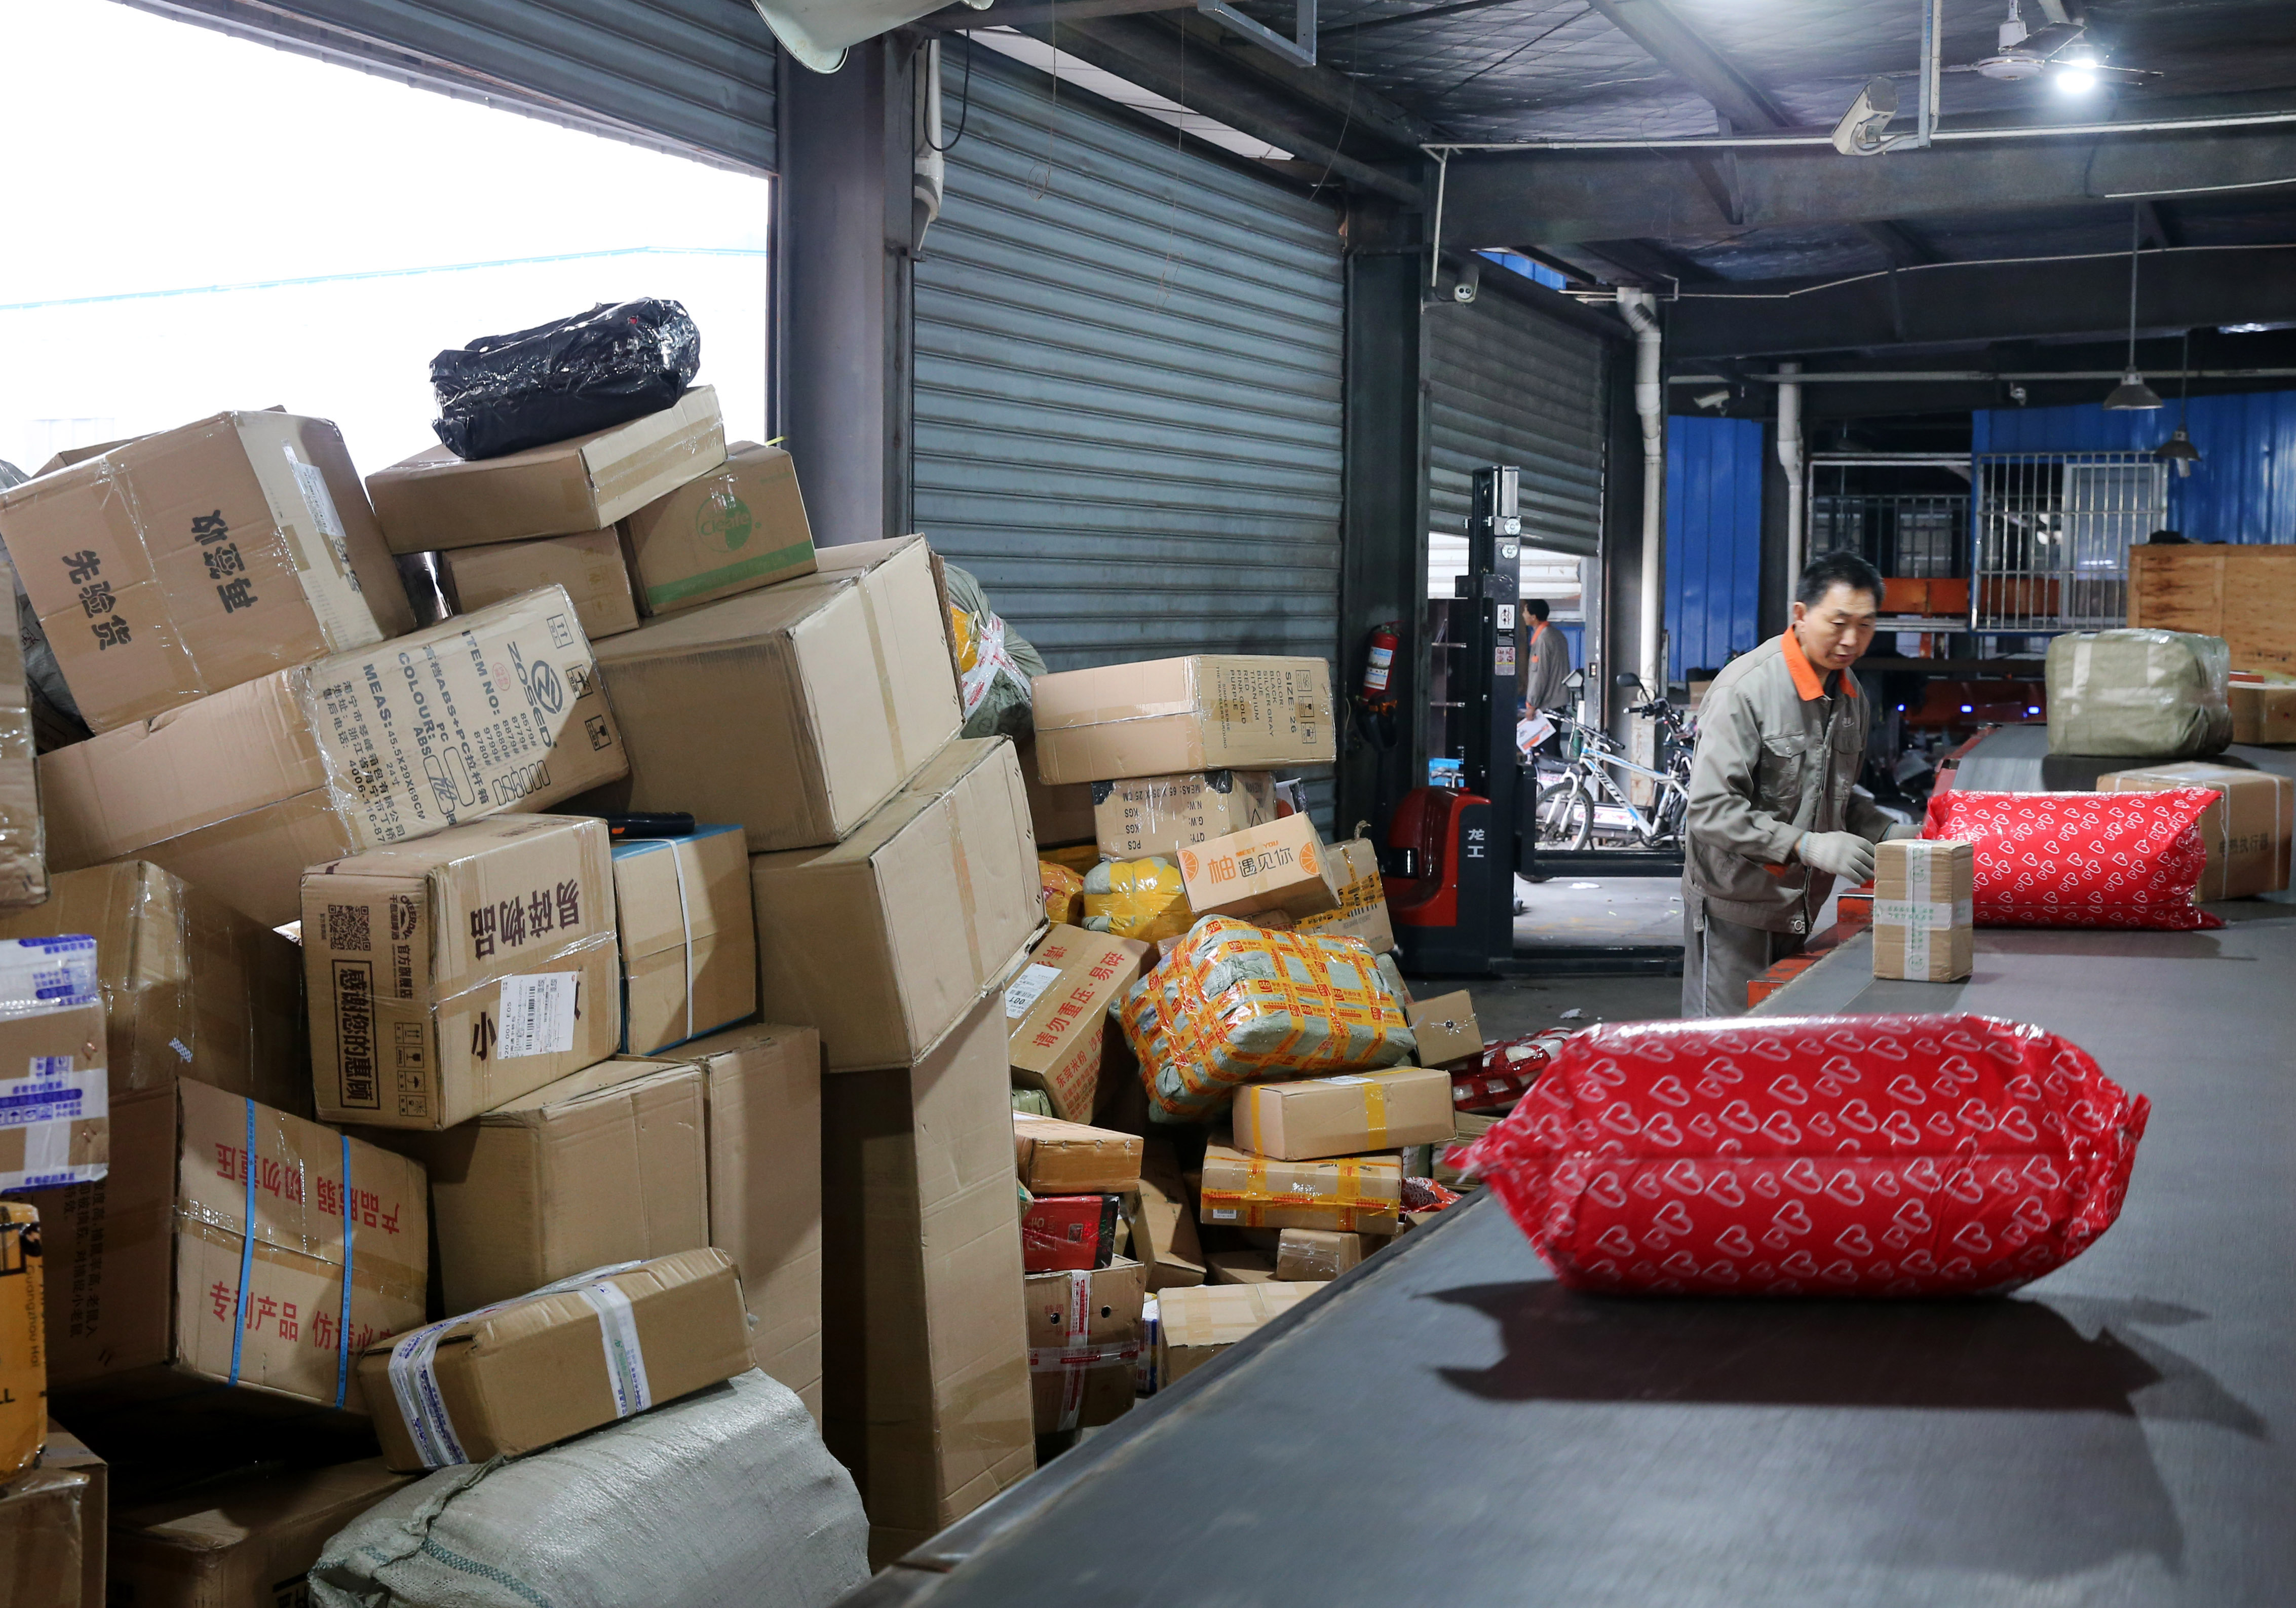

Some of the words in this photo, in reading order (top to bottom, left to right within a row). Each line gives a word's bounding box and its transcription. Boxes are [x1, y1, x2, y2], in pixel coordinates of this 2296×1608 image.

[191, 509, 258, 614] 再签收
[62, 550, 132, 651] 先验货
[462, 630, 487, 677] ITEM
[482, 681, 501, 716] NO:
[1230, 669, 1238, 710] PURPLE
[398, 652, 436, 741] COLOUR:
[507, 641, 552, 747] ZOSED
[1285, 671, 1295, 711] SIZE:
[363, 663, 393, 729] MEAS:
[388, 730, 426, 820] 45.5X29X69CM
[413, 727, 432, 757] ABS
[436, 722, 450, 742] PC
[493, 723, 511, 758] 8680#
[502, 720, 520, 754] 8879#
[511, 716, 528, 751] 8779#
[520, 713, 537, 747] 8579#
[1289, 716, 1297, 733] 26
[474, 731, 492, 767] 8780#
[483, 727, 502, 763] 9799#
[386, 762, 401, 787] 24寸
[1169, 788, 1177, 796] 65
[1179, 784, 1201, 798] MEAS:
[1123, 793, 1133, 802] CM
[1124, 808, 1138, 818] KGS
[1135, 791, 1143, 801] 25
[1126, 824, 1140, 834] KGS
[1128, 840, 1141, 850] PCS
[1190, 832, 1205, 843] QTY:
[1467, 828, 1485, 858] 龙工
[1207, 847, 1293, 885] 柚遇见你
[1236, 846, 1256, 857] MEET
[1262, 840, 1279, 849] YOU
[400, 894, 417, 940] CHEERDAY
[470, 879, 580, 961] 易碎物品
[1207, 922, 1220, 932] sto
[397, 944, 413, 999] 官方旗舰店
[1009, 996, 1026, 1005] 001
[339, 968, 374, 1101] 感谢您的惠顾
[1056, 1050, 1087, 1089] 东莞米粉
[215, 1141, 305, 1207] 切勿重压
[209, 1281, 300, 1342] 专利产品
